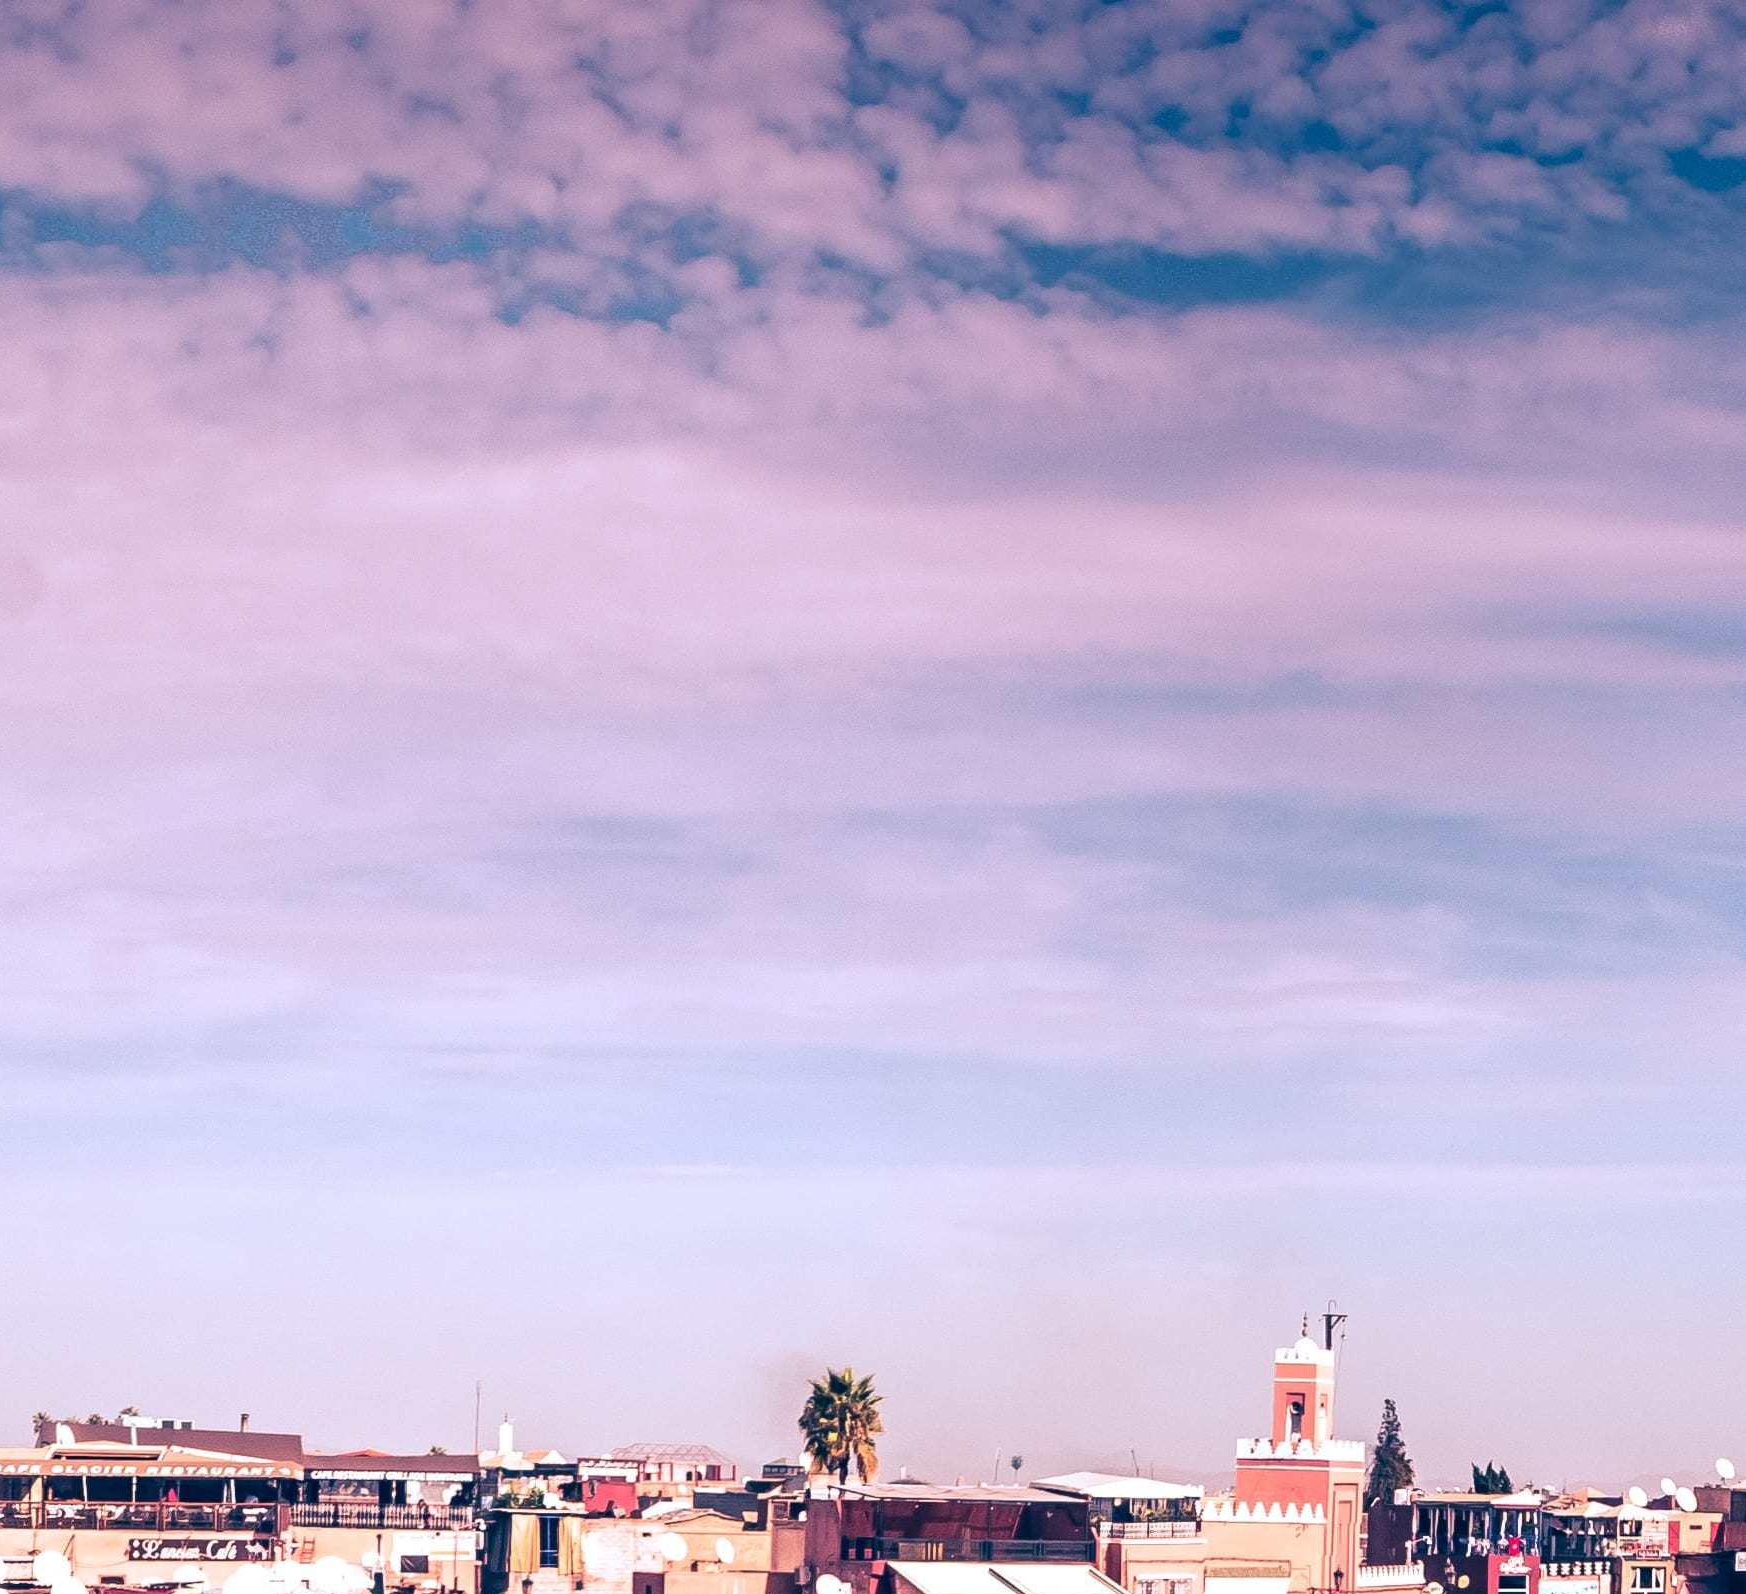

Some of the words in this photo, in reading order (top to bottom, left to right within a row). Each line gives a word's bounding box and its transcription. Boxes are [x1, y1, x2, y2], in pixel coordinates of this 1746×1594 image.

[51, 1465, 137, 1475] GLACIER
[146, 1466, 279, 1477] RESTAURANT
[206, 1540, 237, 1559] Café
